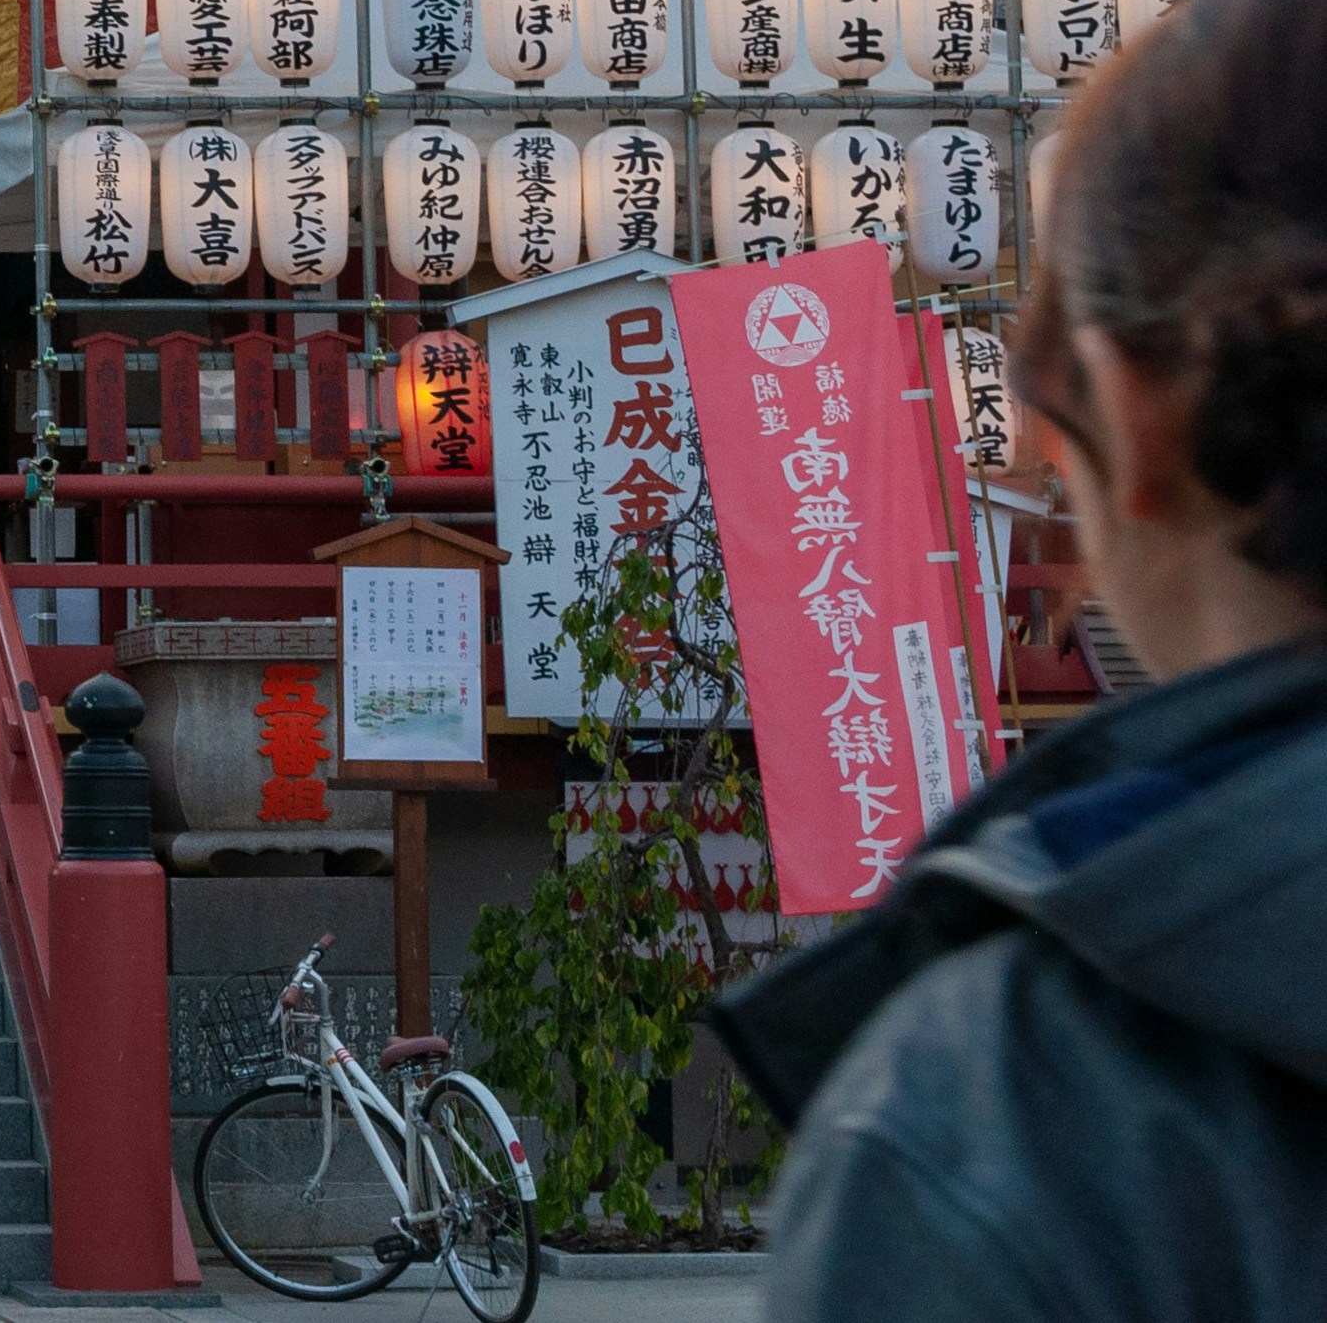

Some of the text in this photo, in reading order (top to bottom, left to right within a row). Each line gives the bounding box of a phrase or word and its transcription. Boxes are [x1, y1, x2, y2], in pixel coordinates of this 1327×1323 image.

[189, 135, 240, 267] (株)大喜
[285, 135, 327, 276] スタッフアドバンス
[849, 136, 892, 238] いかる
[942, 135, 983, 271] たまゆら
[510, 342, 536, 426] 寛永寺
[540, 342, 565, 423] 東叡山
[567, 359, 601, 604] 小判のお守と、福財布
[603, 307, 687, 690] 巳成金
[256, 665, 332, 823] 五番組
